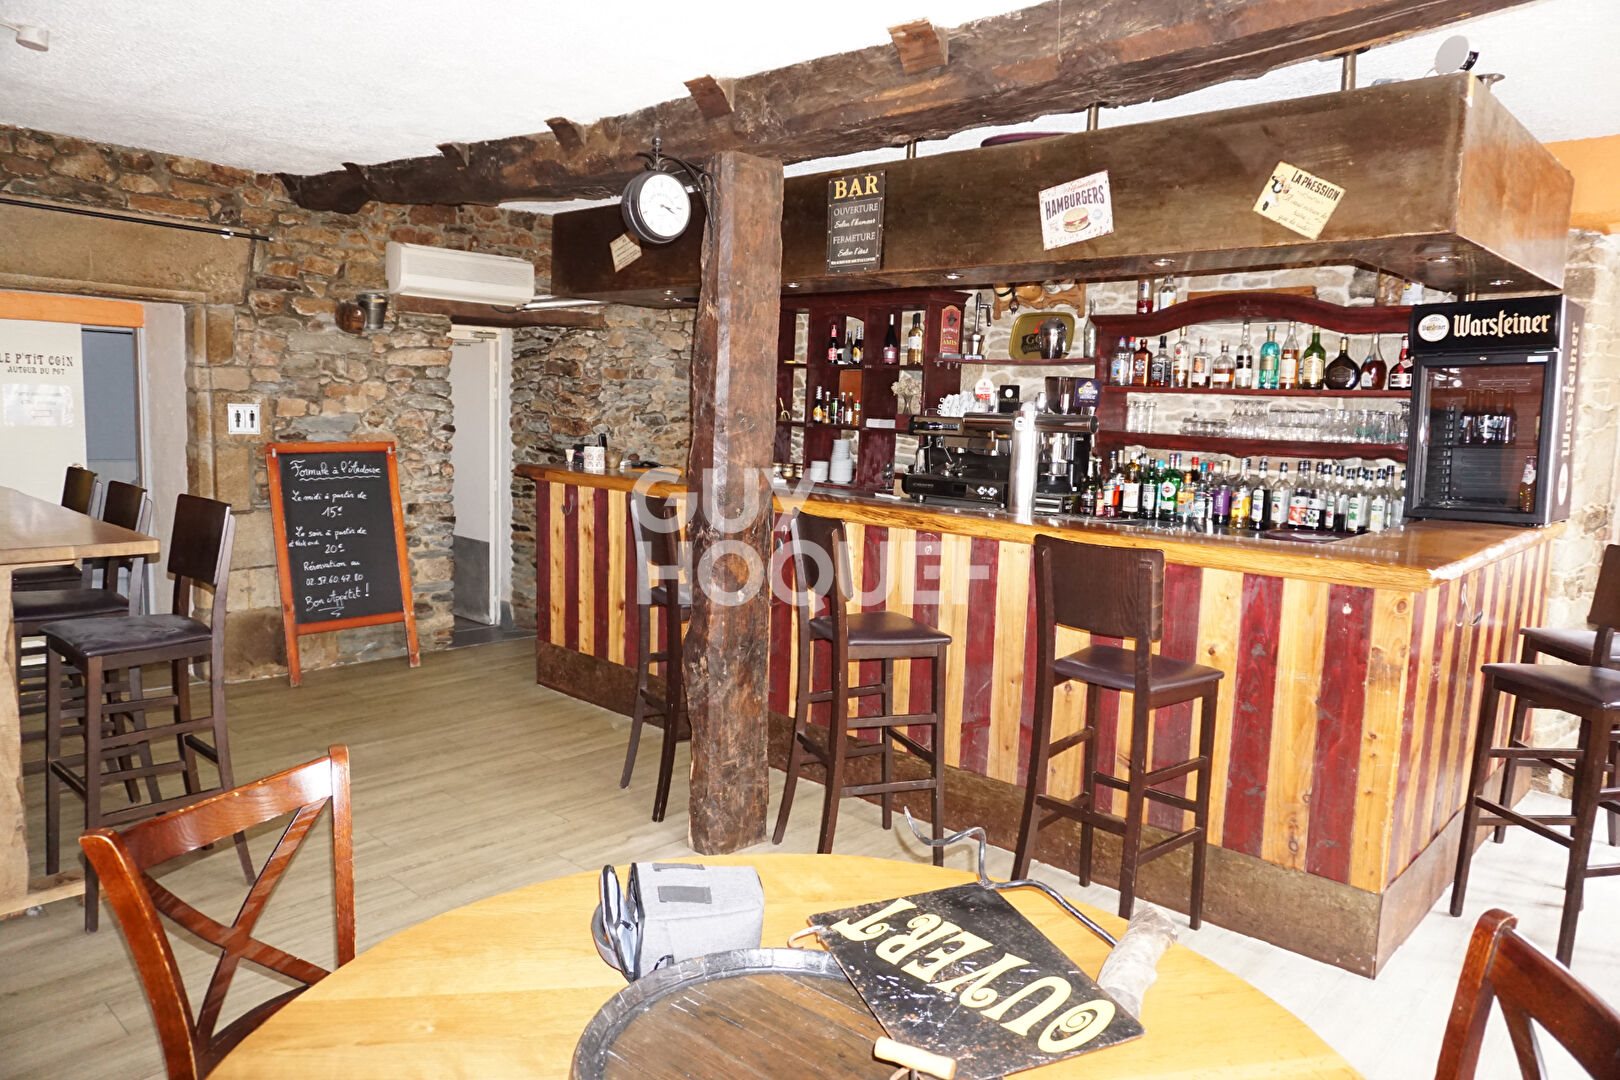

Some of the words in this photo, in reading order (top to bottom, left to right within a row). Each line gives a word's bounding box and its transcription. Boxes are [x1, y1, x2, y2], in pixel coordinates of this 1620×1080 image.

[834, 175, 879, 200] BAR
[1291, 170, 1303, 185] LA
[1300, 176, 1341, 201] PRESSION
[833, 203, 879, 216] OUVERTURE
[1045, 185, 1105, 220] HAMBURGERS
[832, 232, 876, 244] FERMETURE
[1453, 310, 1551, 338] Warsteiner
[0, 352, 11, 363] LE
[40, 367, 50, 375] DU
[289, 459, 329, 477] Formule
[332, 466, 339, 474] à
[291, 490, 302, 501] Le
[303, 492, 321, 500] midi
[357, 491, 368, 500] de
[356, 527, 367, 535] de
[303, 560, 346, 571] Réservation
[305, 595, 325, 612] Bon
[326, 585, 361, 607] Appétit
[831, 897, 1116, 1053] OUVERT
